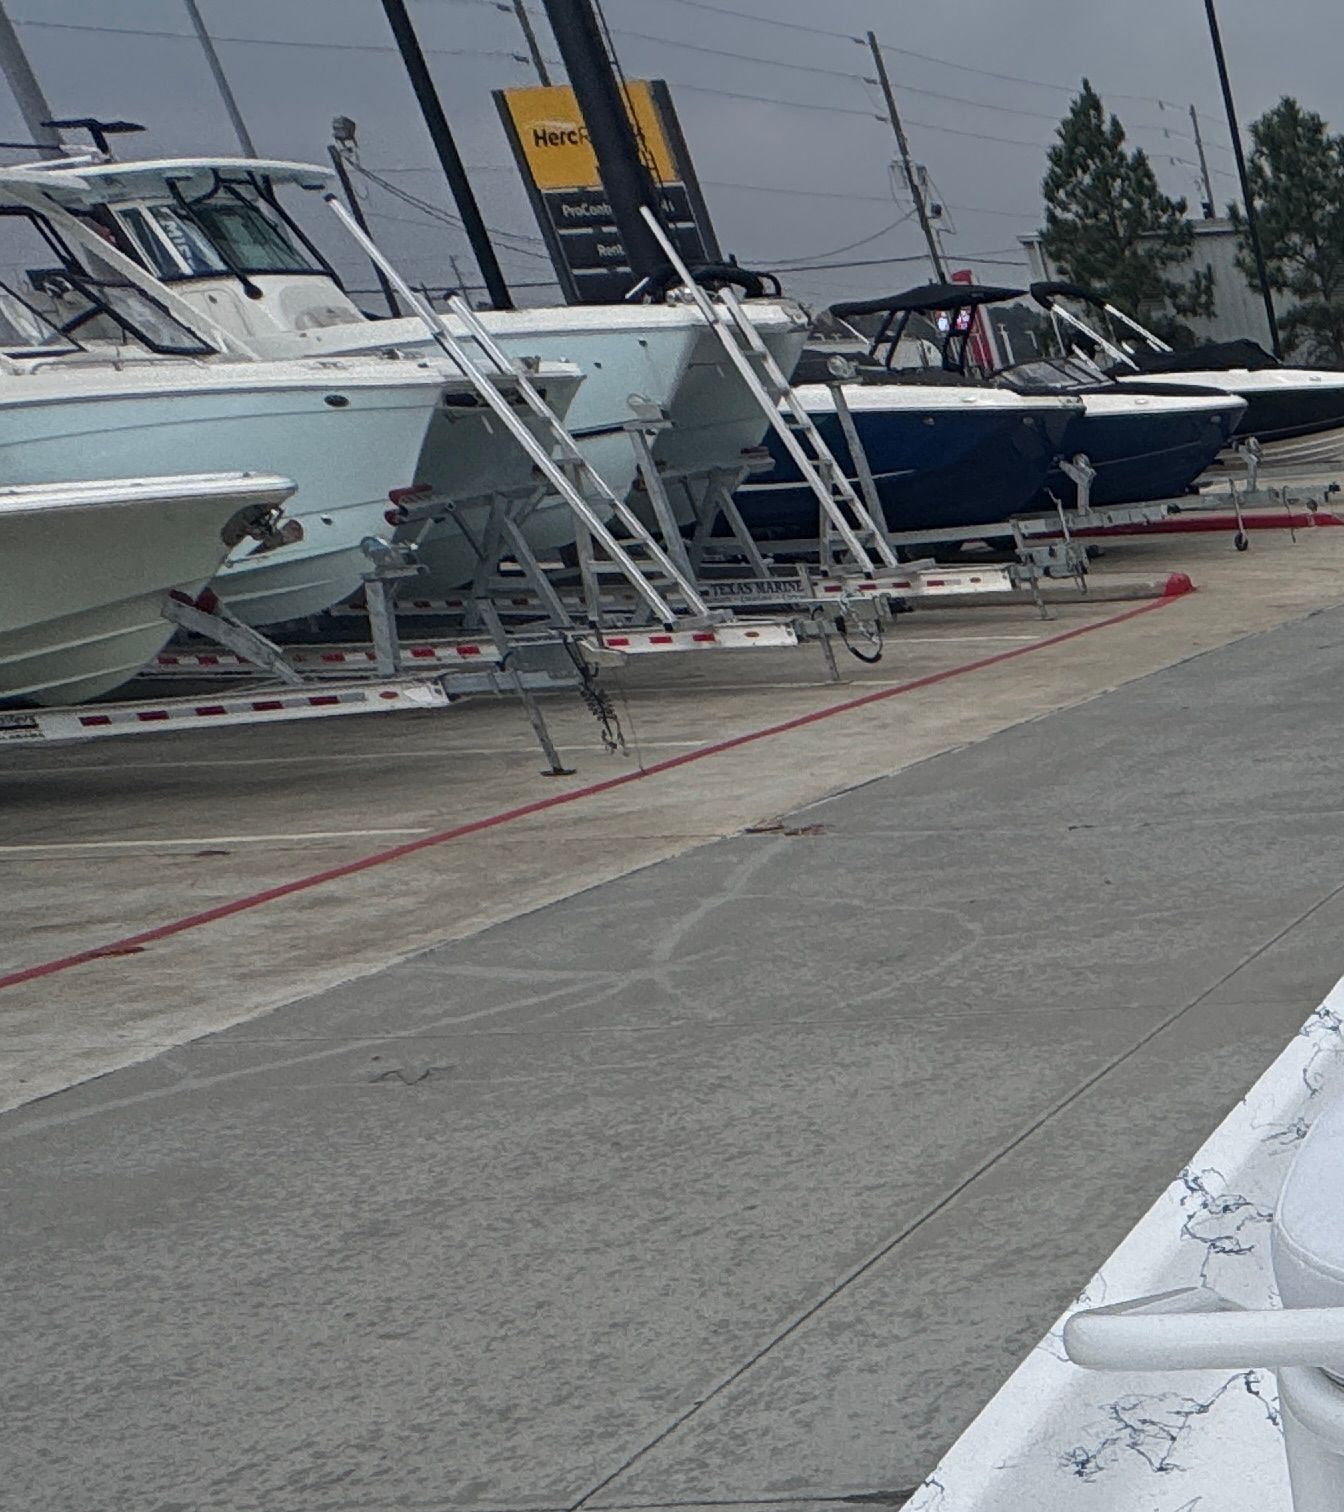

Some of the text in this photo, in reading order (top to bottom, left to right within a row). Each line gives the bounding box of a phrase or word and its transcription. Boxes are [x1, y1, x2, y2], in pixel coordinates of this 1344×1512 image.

[533, 126, 592, 147] HercR
[597, 244, 626, 257] Rent
[711, 583, 753, 596] TEXAS
